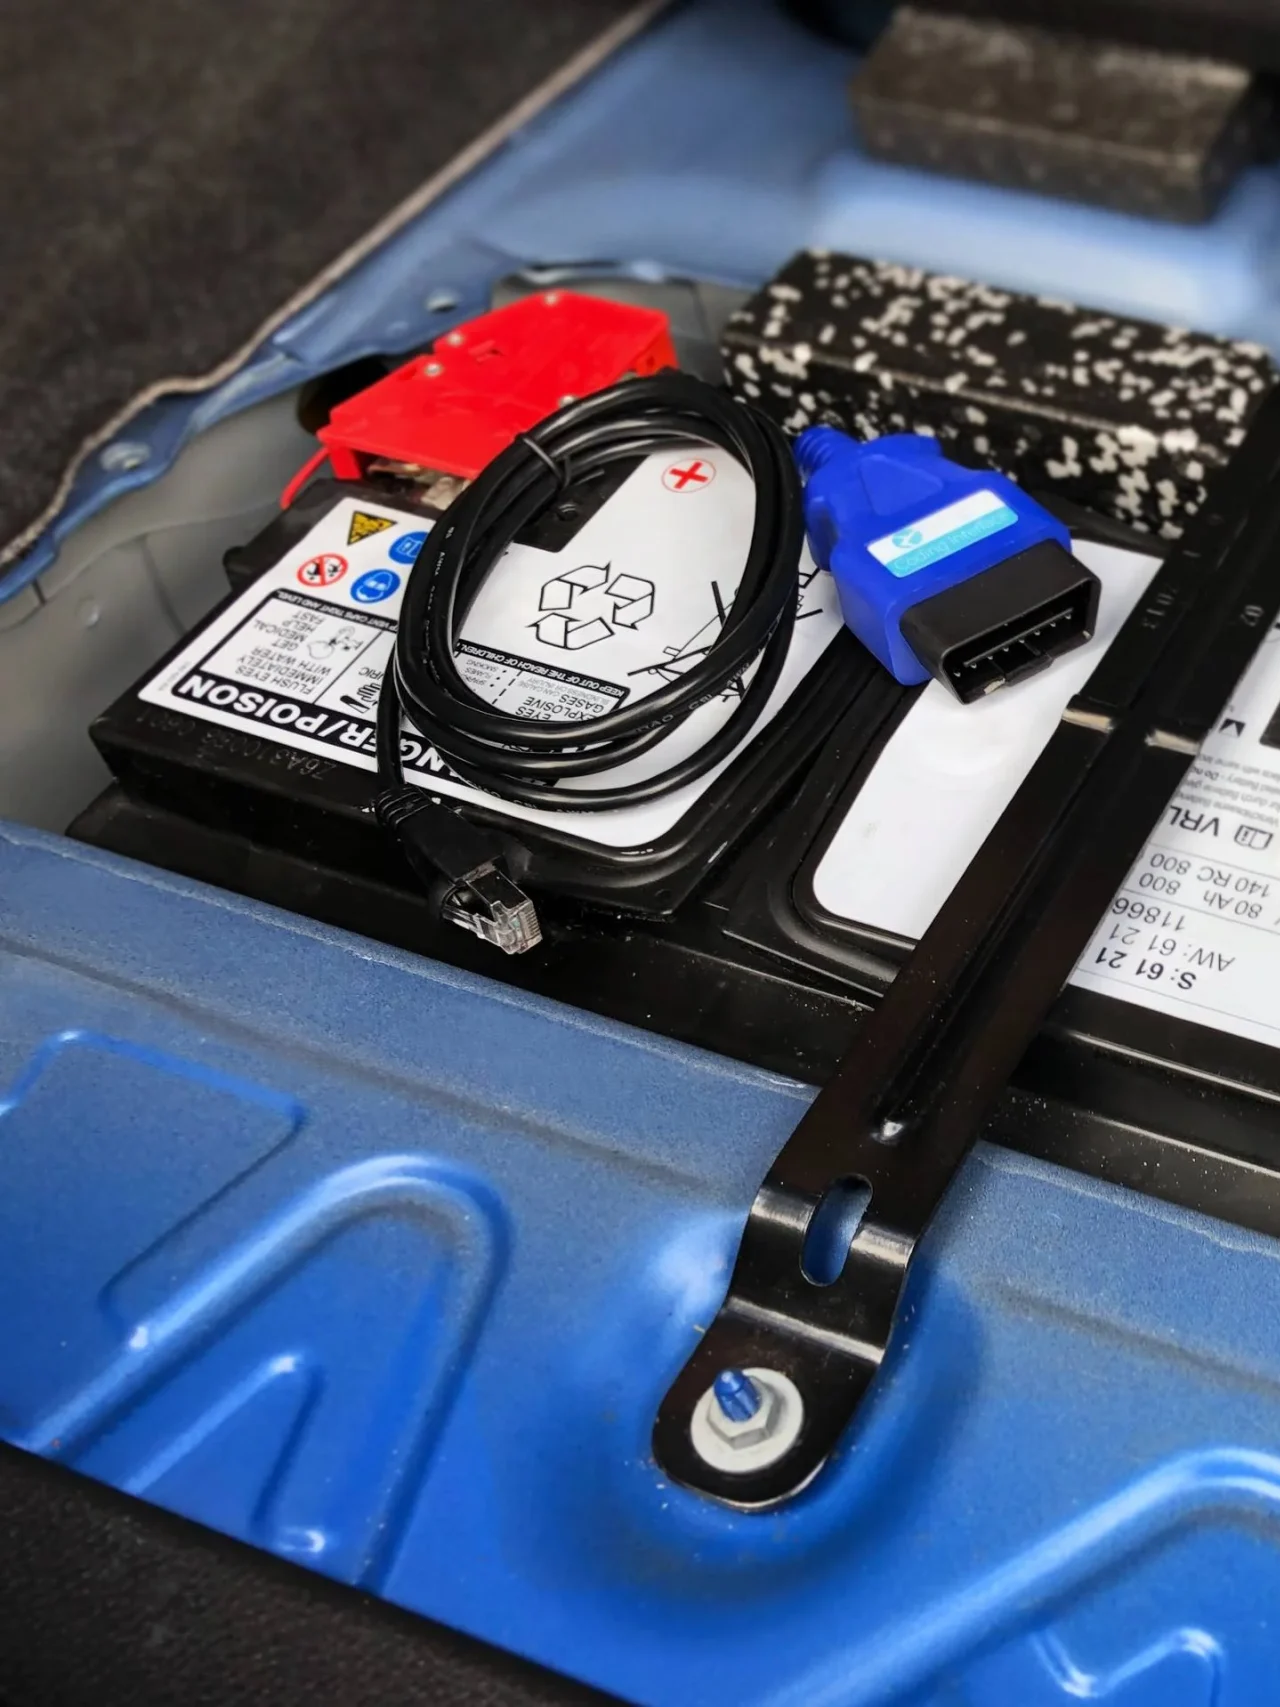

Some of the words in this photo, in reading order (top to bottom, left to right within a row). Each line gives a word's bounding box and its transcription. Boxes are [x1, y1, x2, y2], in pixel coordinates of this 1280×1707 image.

[282, 618, 317, 633] HELP
[292, 609, 327, 626] FAST
[254, 618, 308, 643] MEDICAL
[251, 647, 297, 665] WATER
[272, 638, 299, 653] GET
[238, 654, 326, 686] IMMEDIATELY
[297, 660, 332, 676] WITH
[503, 657, 519, 668] OF
[517, 661, 550, 676] REACH
[235, 665, 271, 682] EYES
[547, 669, 567, 681] THE
[565, 676, 581, 685] OF
[273, 676, 316, 695] FLUSH
[579, 679, 600, 690] OUT
[599, 685, 625, 698] KEEP
[559, 693, 605, 714] GASES
[1204, 769, 1220, 781] Do
[1149, 852, 1192, 875] 800
[1138, 872, 1182, 896] 800
[1196, 865, 1232, 888] RC
[1235, 876, 1271, 899] 140
[1203, 889, 1233, 911] Ah
[1234, 899, 1263, 920] 80
[1111, 896, 1187, 933] 11866
[1109, 922, 1141, 946] 21
[1147, 934, 1177, 957] 61
[1095, 947, 1128, 970] 21
[1182, 942, 1236, 973] AW:
[1135, 958, 1165, 981] 61
[1171, 967, 1198, 991] S:
